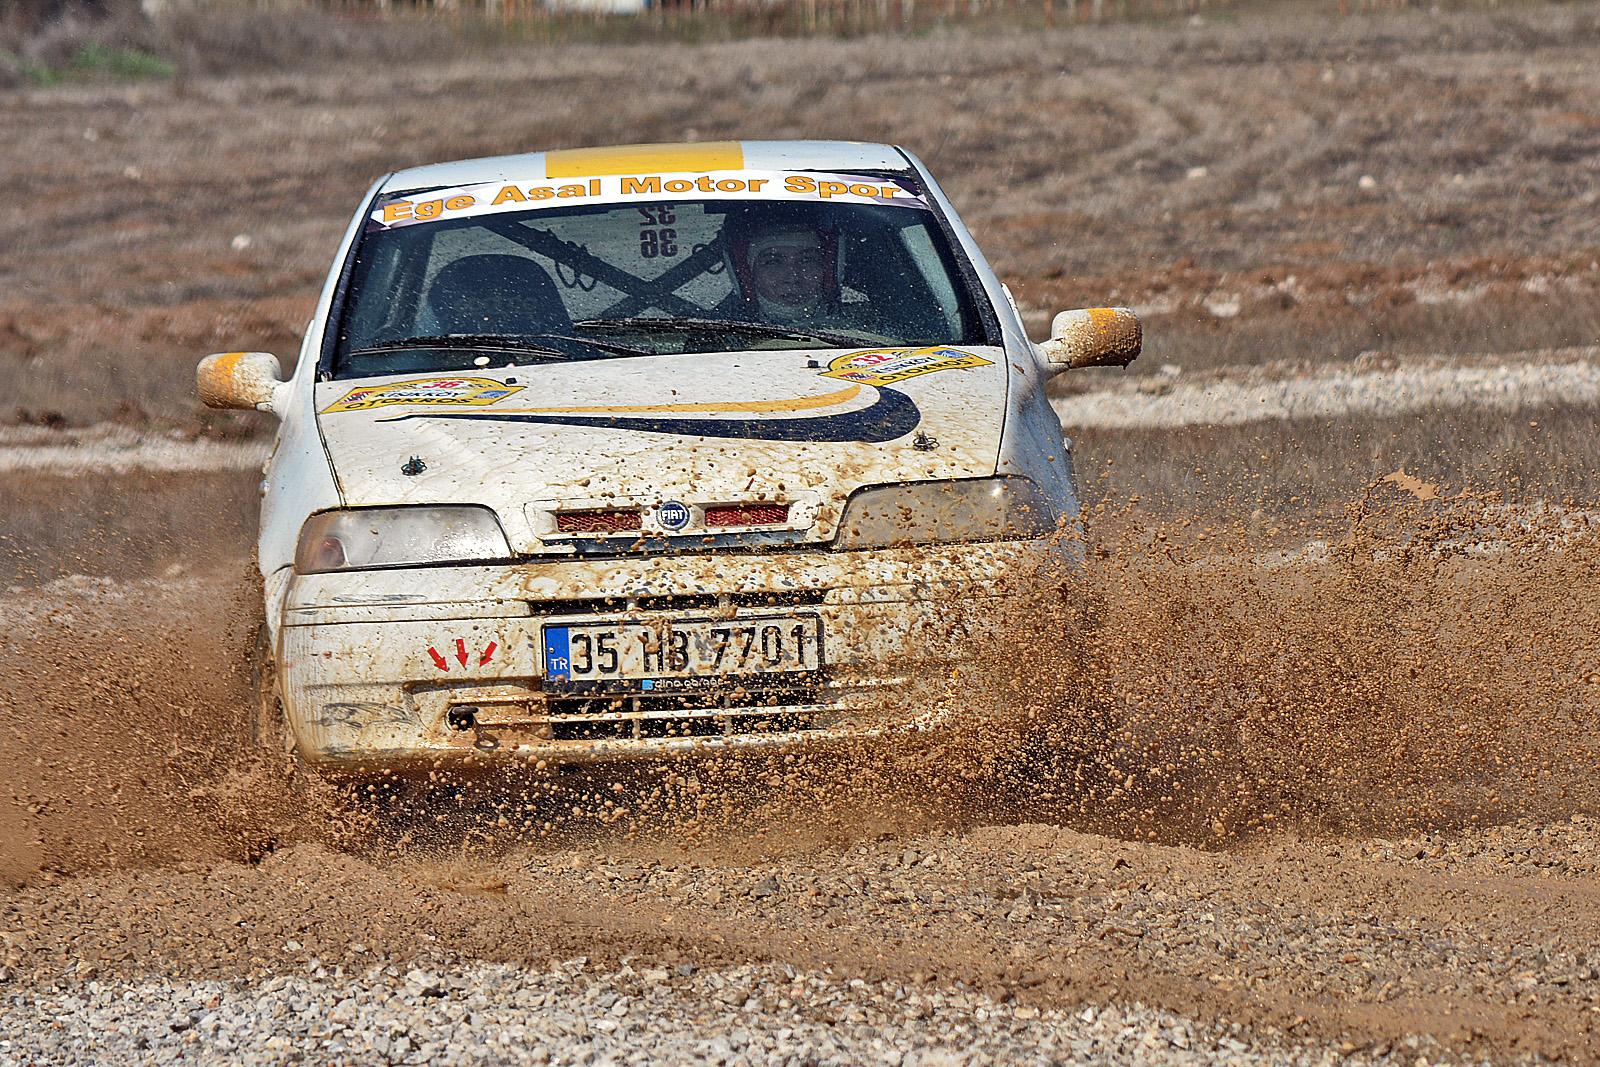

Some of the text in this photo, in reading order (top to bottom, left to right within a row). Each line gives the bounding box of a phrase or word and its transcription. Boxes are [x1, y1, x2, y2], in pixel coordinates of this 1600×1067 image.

[383, 175, 901, 222] Ege Asal Motor Spor
[853, 354, 894, 365] 32
[879, 358, 973, 381] OTOKROS
[661, 509, 684, 521] FIAT
[571, 624, 805, 674] 35 HB 7701
[551, 658, 568, 671] TR
